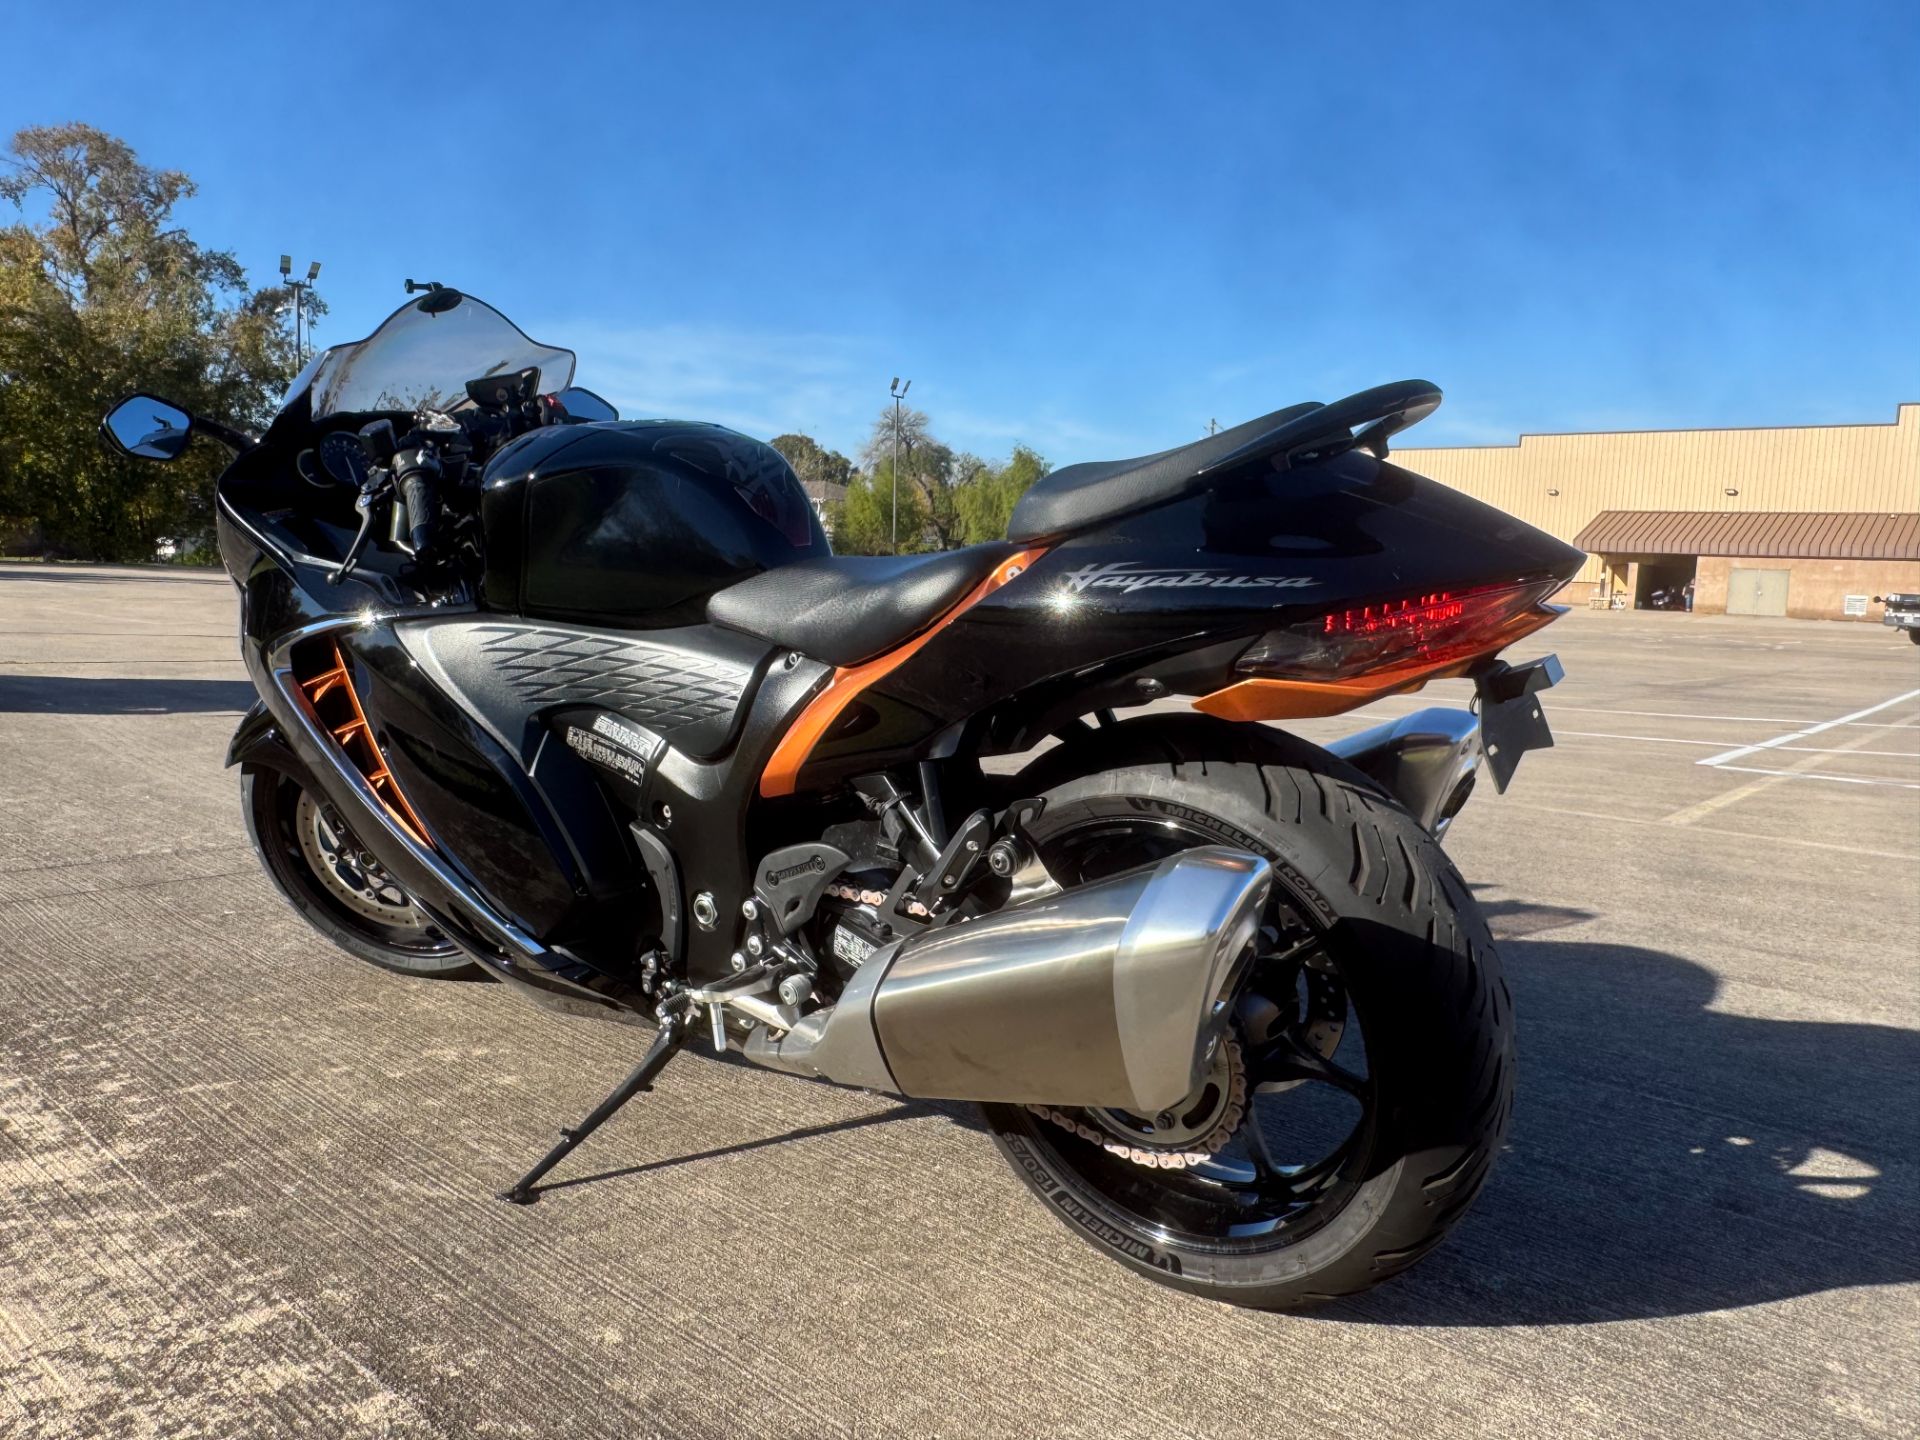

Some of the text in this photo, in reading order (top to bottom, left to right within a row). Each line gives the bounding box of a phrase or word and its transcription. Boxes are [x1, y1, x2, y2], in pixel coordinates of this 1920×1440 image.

[1064, 561, 1324, 594] Hayabusa
[1163, 803, 1270, 857] MICHELIN
[1282, 866, 1330, 912] ROAD
[1059, 1197, 1150, 1259] MICHELIN
